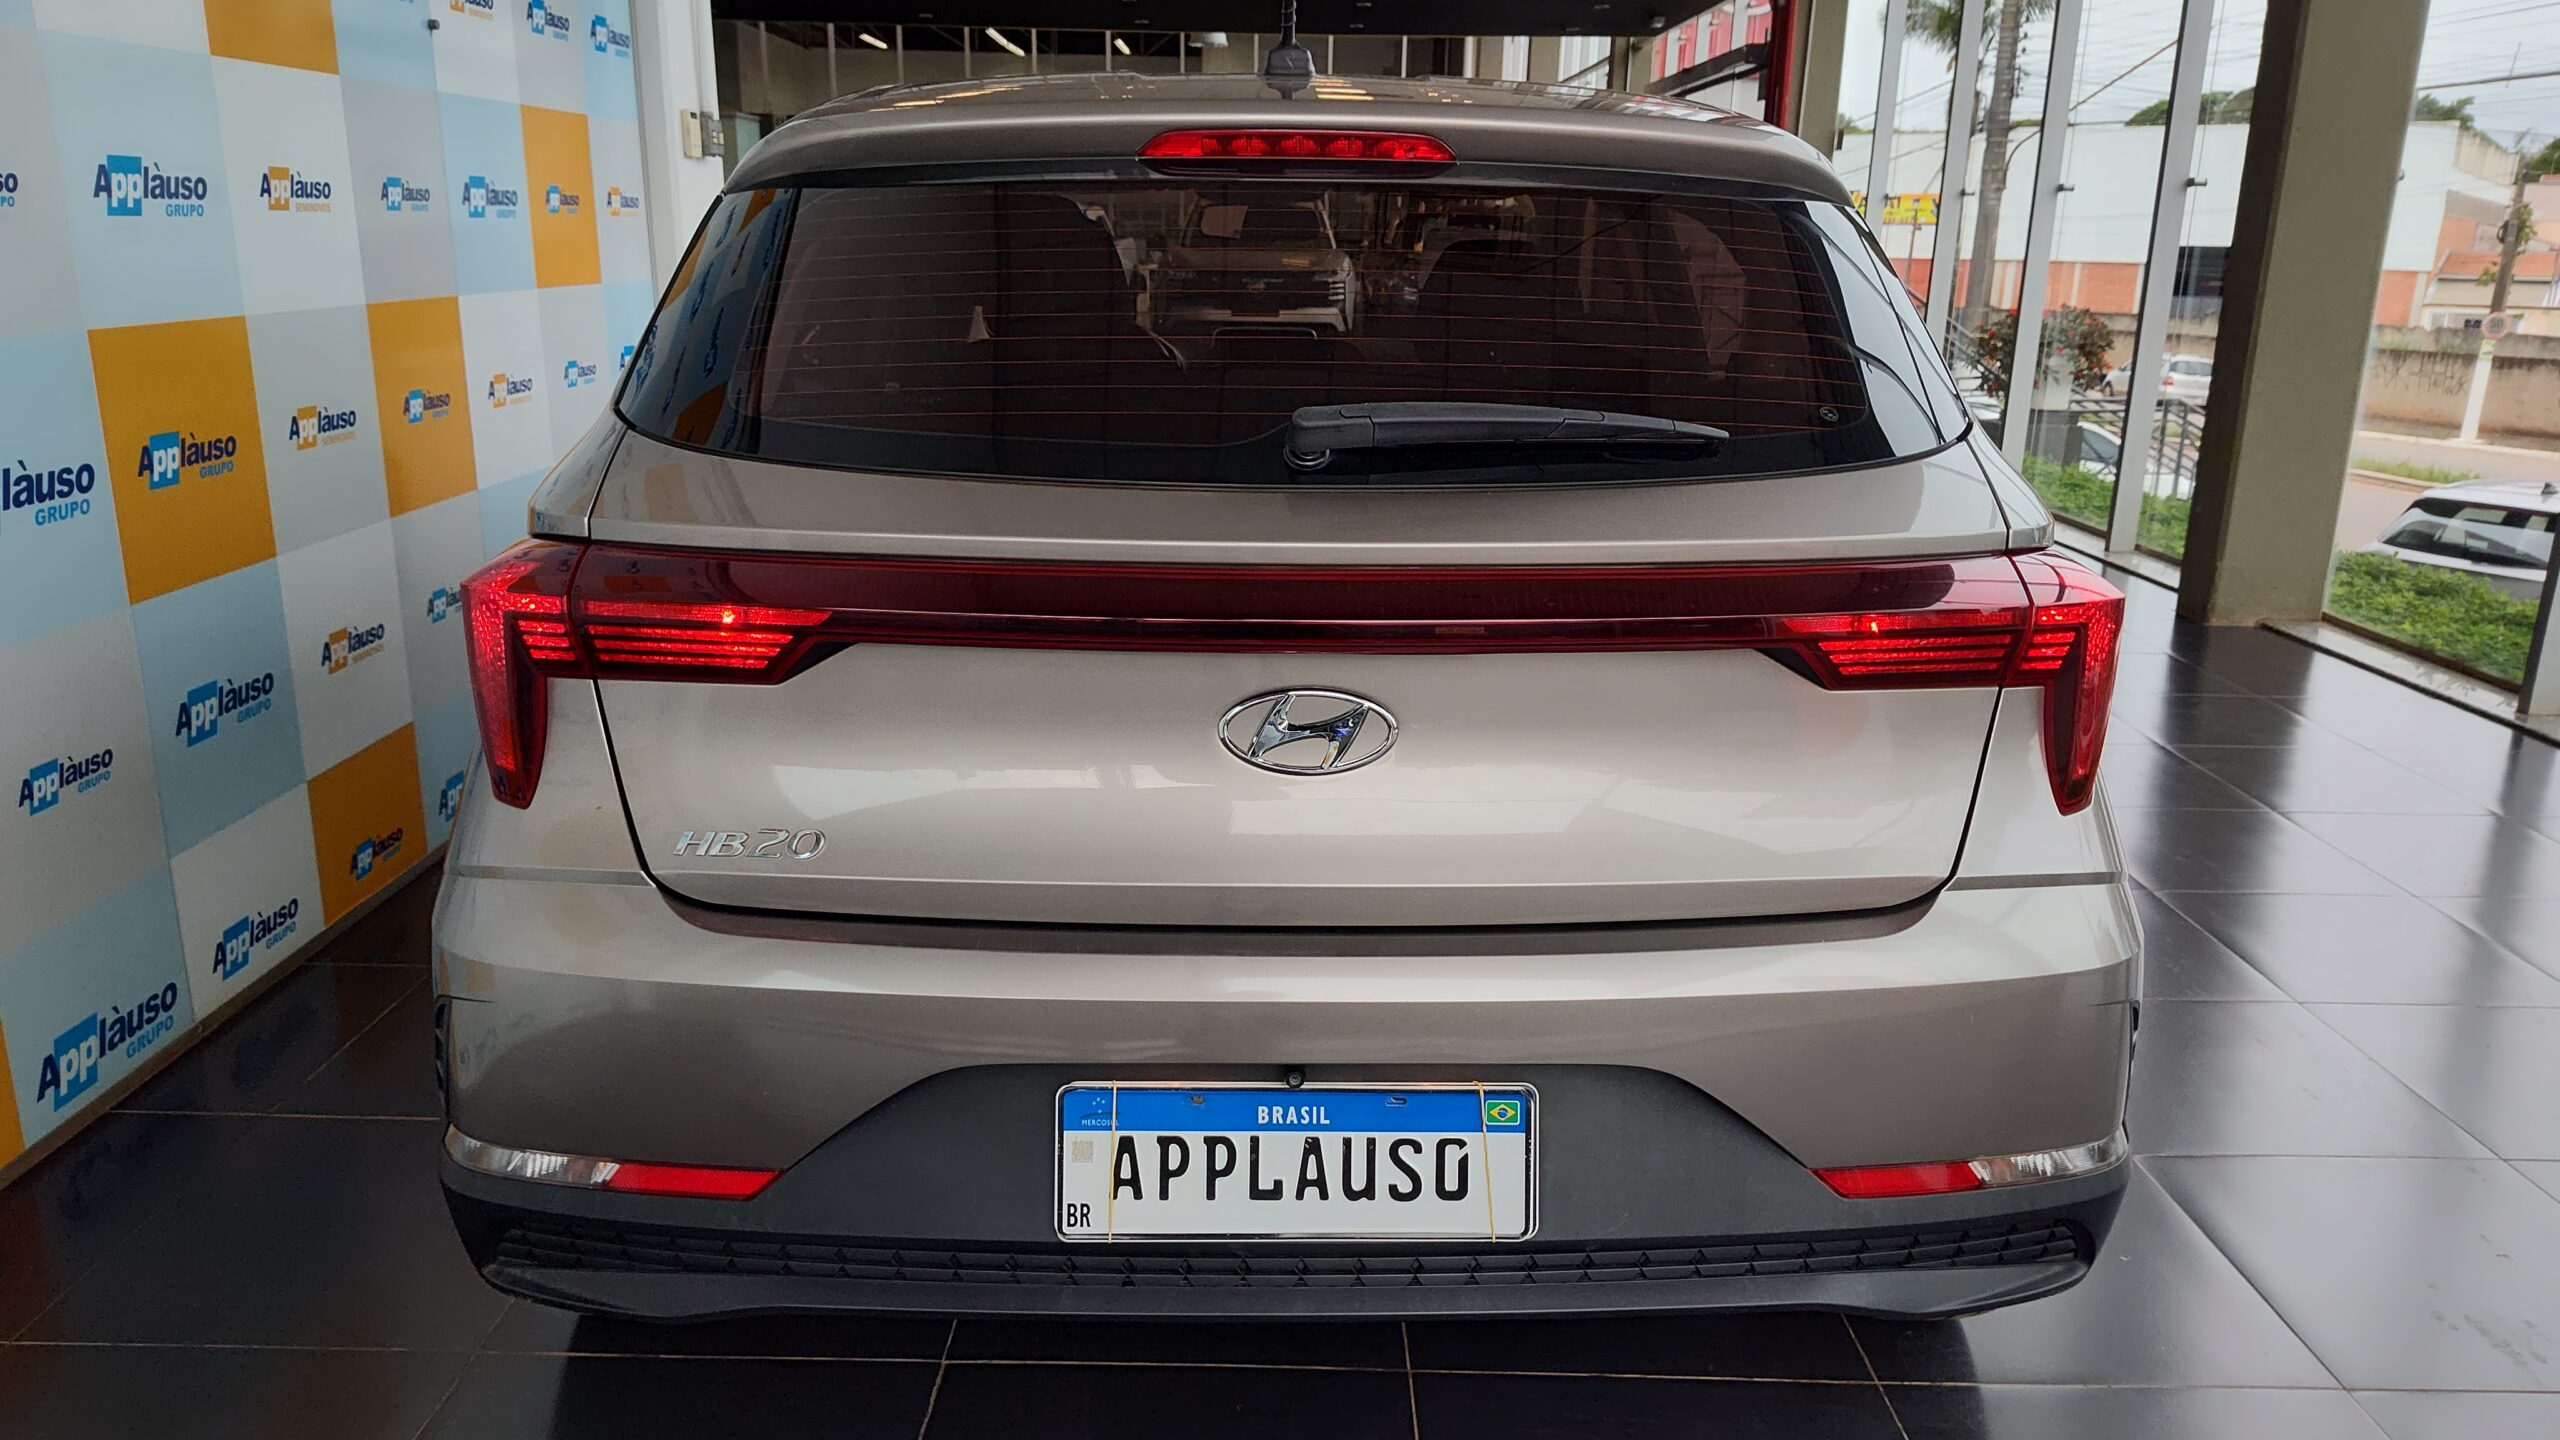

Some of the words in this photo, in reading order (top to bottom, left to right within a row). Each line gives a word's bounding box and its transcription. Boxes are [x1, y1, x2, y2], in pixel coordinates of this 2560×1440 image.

[93, 162, 207, 208] Applàuso
[165, 203, 204, 217] GRUPO
[137, 432, 237, 482] Applàuso
[200, 460, 234, 478] GRUPO
[2, 459, 95, 511] làuso
[35, 499, 90, 526] GRUPO
[175, 672, 274, 738] Applàuso
[237, 698, 272, 724] GRUPO
[19, 748, 113, 808] Applàuso
[78, 770, 110, 793] GRUPO
[672, 828, 827, 861] HB20
[213, 898, 298, 975] Applàuso
[265, 921, 297, 950] GRUPO
[37, 982, 177, 1103] Applàuso
[126, 1014, 174, 1059] GRUPO
[1257, 1106, 1330, 1124] BRASIL
[1110, 1135, 1470, 1202] APPLAUSO
[1066, 1203, 1091, 1228] BR
